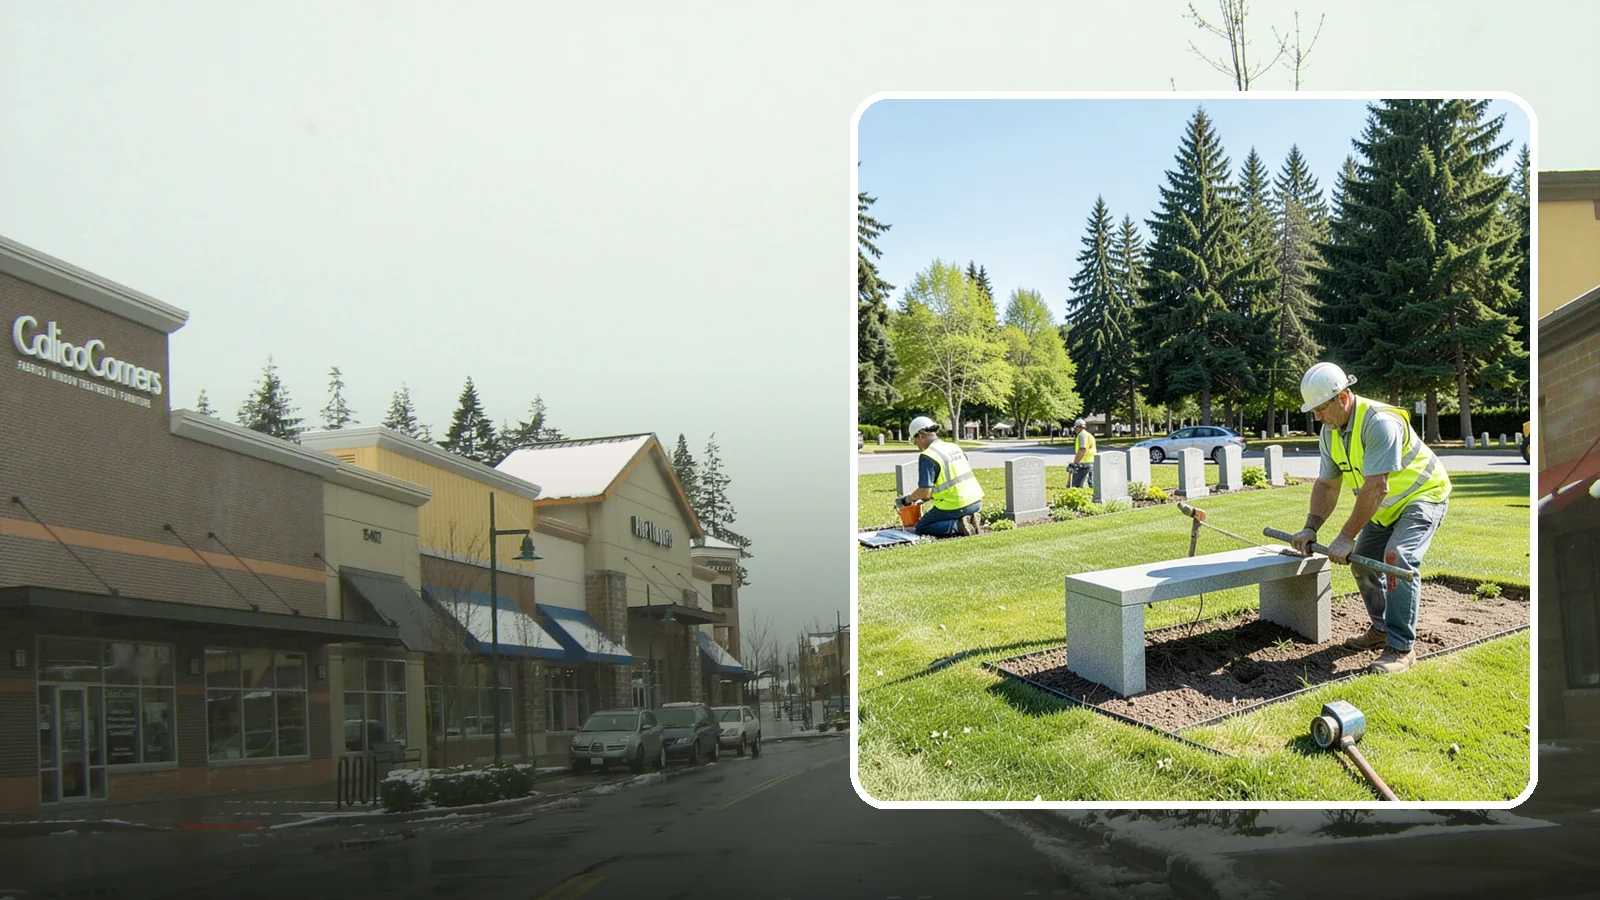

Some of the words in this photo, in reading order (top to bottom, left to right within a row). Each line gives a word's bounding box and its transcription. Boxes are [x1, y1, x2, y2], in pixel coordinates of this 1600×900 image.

[17, 360, 47, 377] FABRICS
[50, 369, 78, 386] WINDOW
[78, 378, 117, 398] TREATMENTS
[119, 390, 151, 409] FURNITURE
